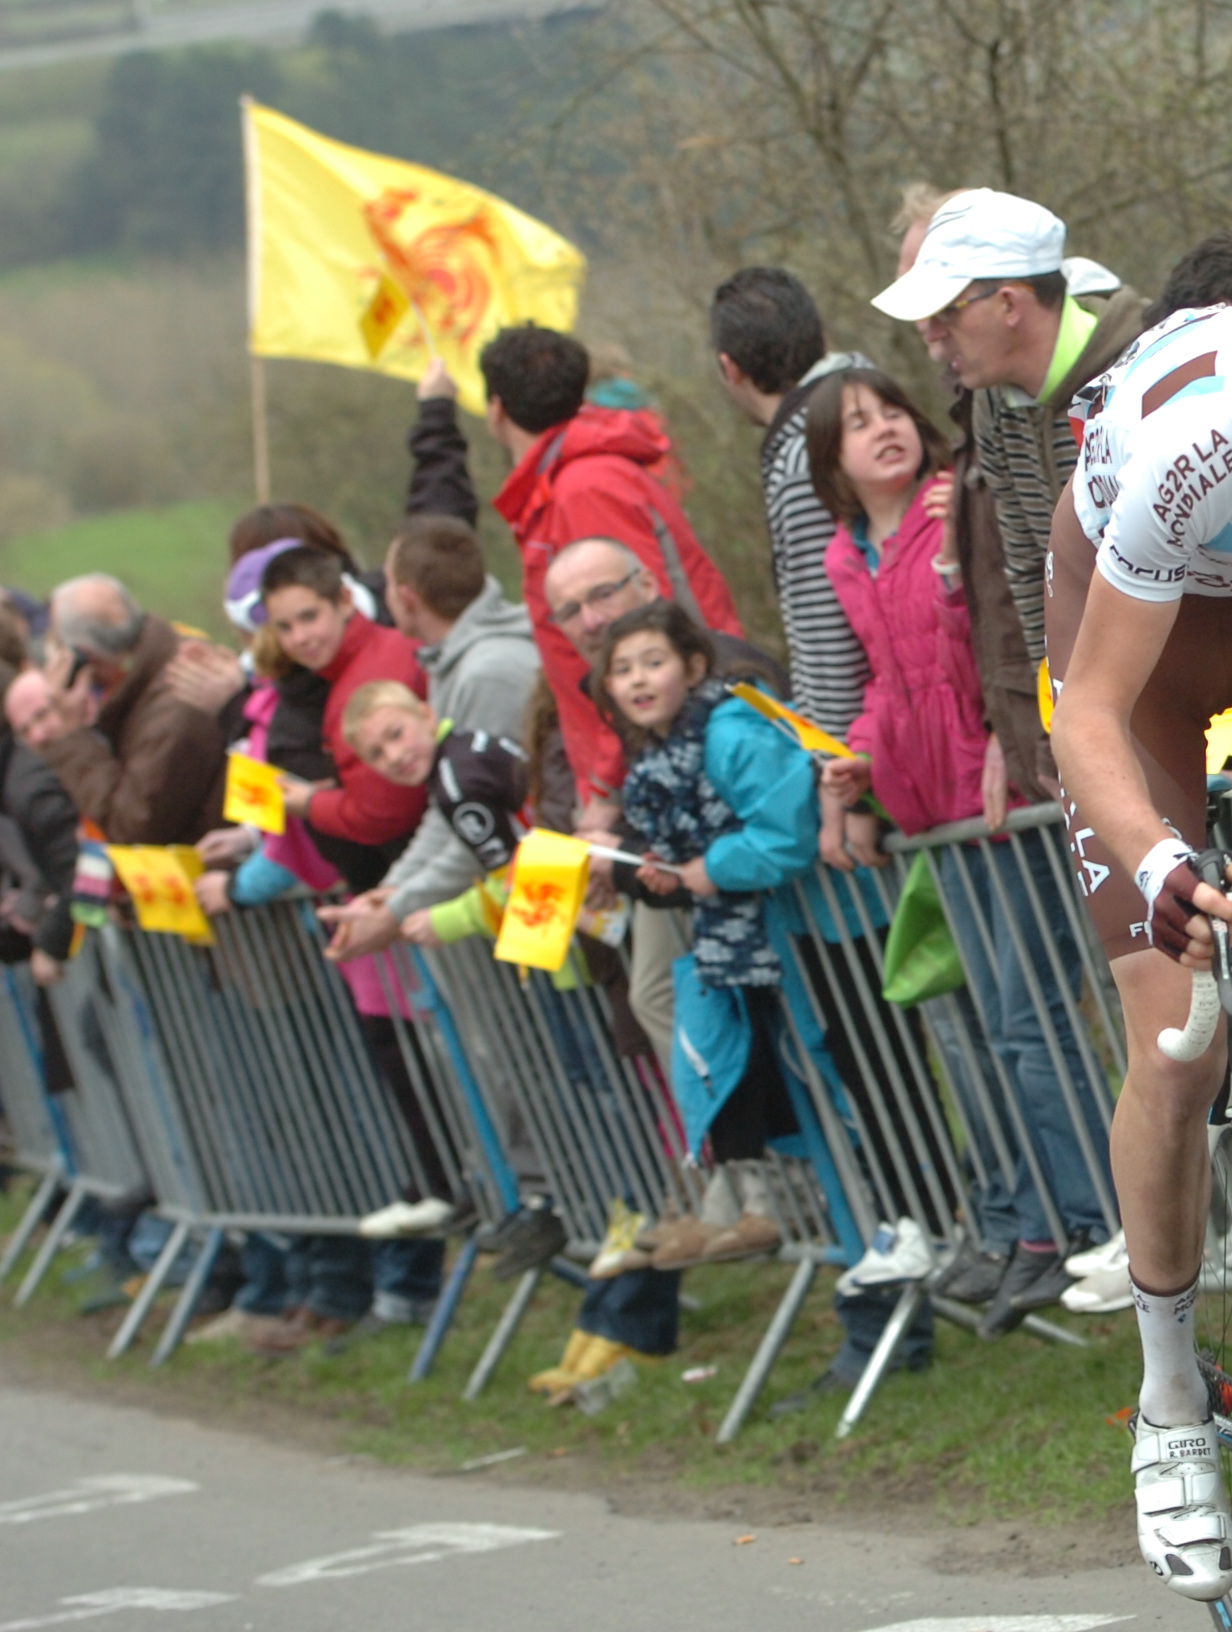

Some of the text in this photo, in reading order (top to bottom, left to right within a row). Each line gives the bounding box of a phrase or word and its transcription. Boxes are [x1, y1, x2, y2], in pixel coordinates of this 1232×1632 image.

[1153, 428, 1229, 523] AG2R LA
[1168, 1438, 1206, 1449] GIRO
